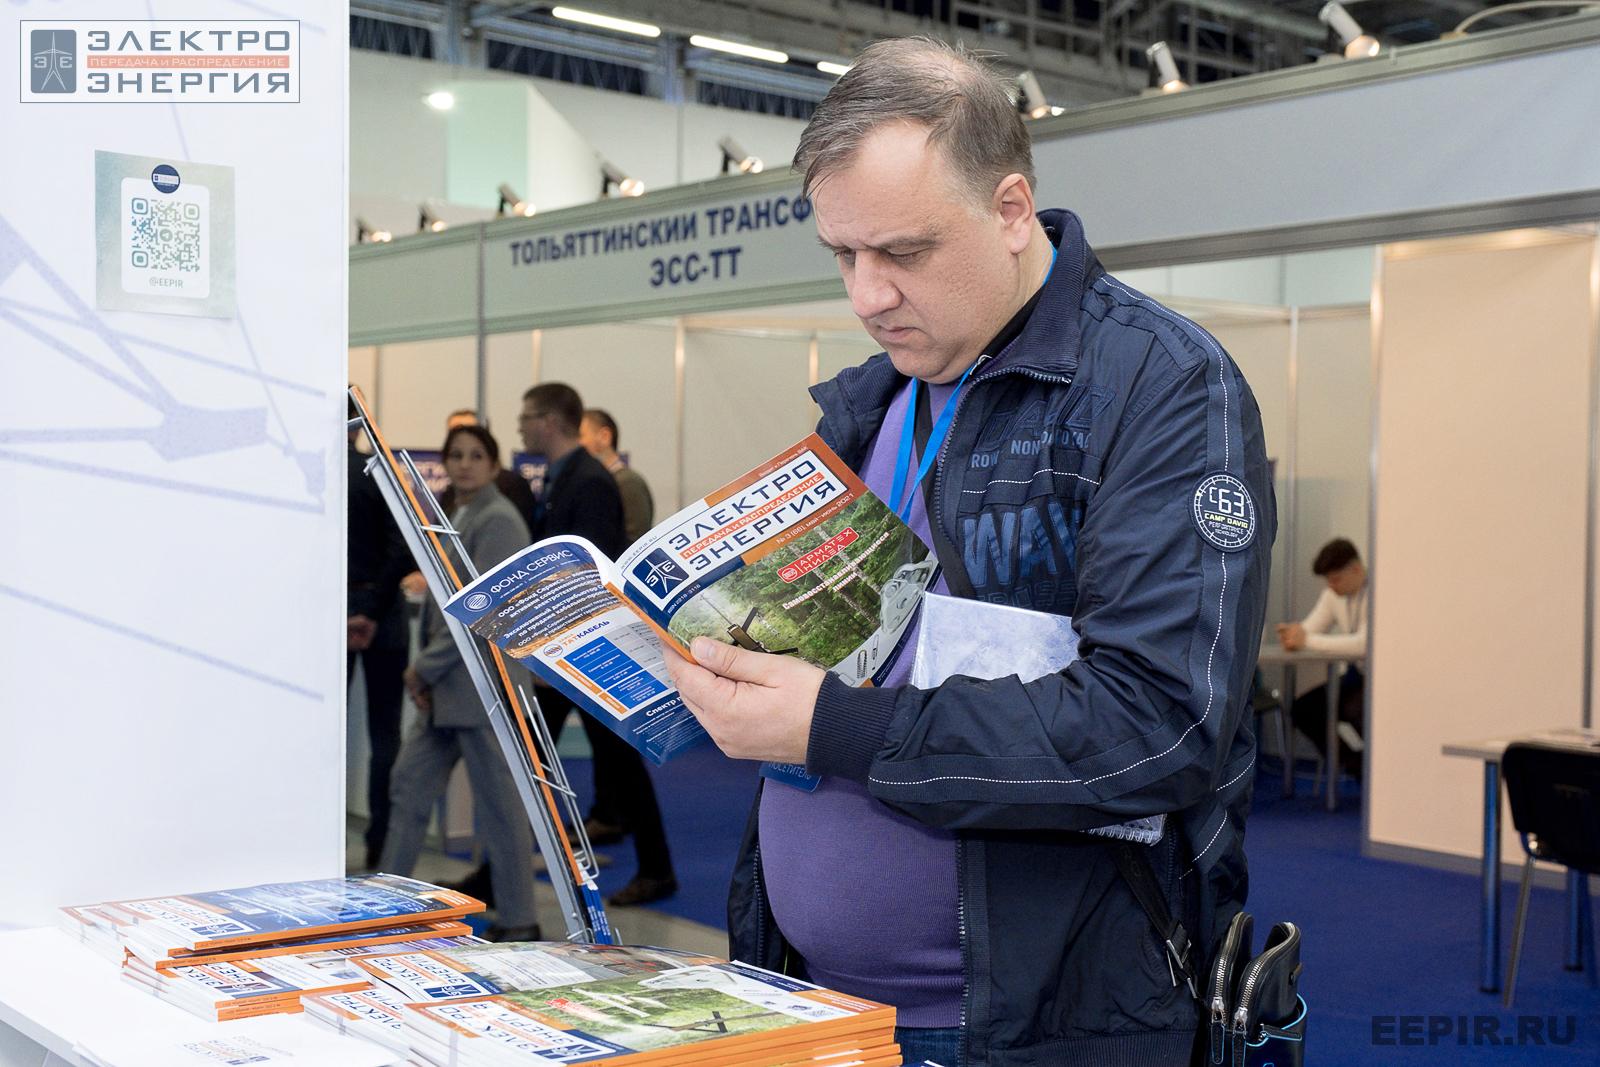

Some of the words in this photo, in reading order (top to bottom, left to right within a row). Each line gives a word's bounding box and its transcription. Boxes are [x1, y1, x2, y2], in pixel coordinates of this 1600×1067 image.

[649, 246, 743, 288] ЭСС-ТТ
[668, 459, 817, 551] ЭЛЕКТРО
[682, 525, 733, 559] ПЕРЕДАЧА
[739, 474, 822, 525] РАСПРЕДЕЛЕНИЕ
[689, 480, 837, 571] ЭНЕРГИЯ
[1204, 513, 1226, 523] CAMP
[1226, 518, 1249, 529] DAVID
[490, 568, 530, 595] ФОНД
[526, 549, 574, 572] СЕРВИС
[498, 605, 515, 618] ООО
[503, 607, 552, 639] Эксклюзивный
[645, 698, 677, 718] Спектр
